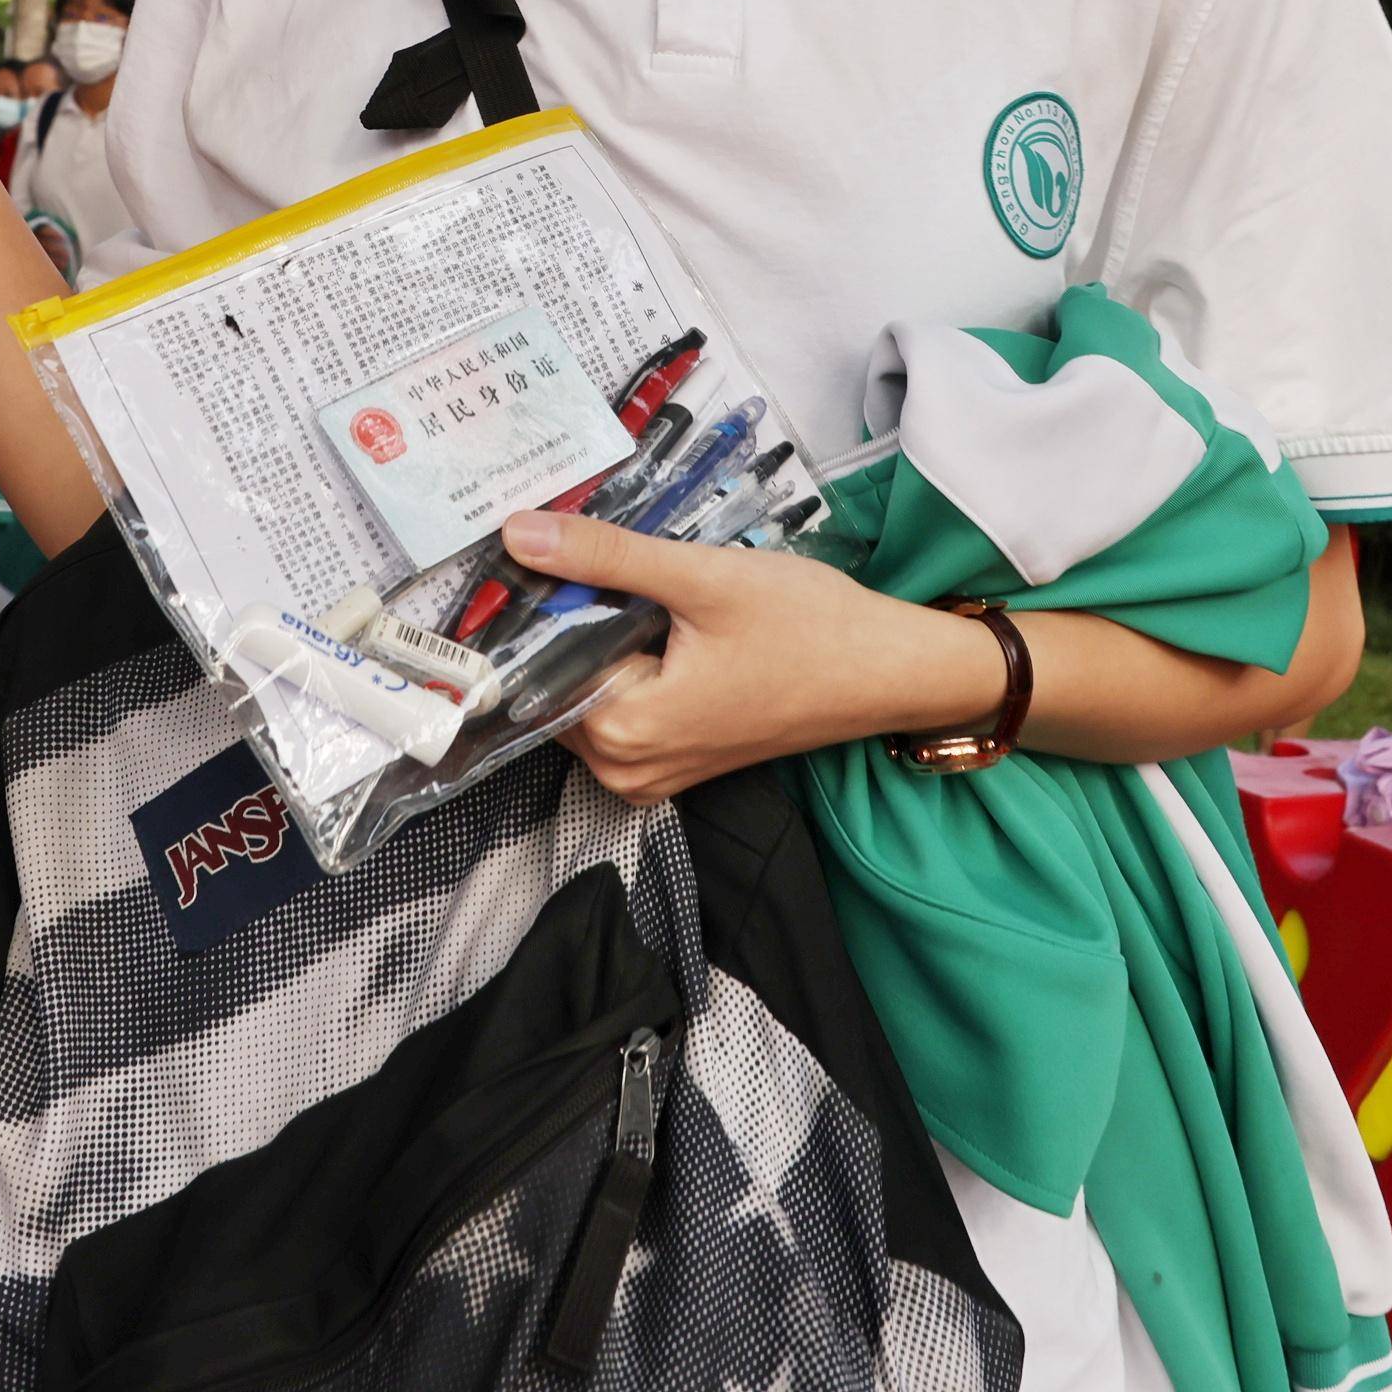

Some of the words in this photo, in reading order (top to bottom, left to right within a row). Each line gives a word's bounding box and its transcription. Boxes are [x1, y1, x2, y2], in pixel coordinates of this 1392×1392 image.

[994, 124, 1029, 236] Guangzhou
[408, 330, 530, 402] 中华人民共和国
[418, 353, 561, 440] 居民身份证
[280, 610, 365, 668] energy
